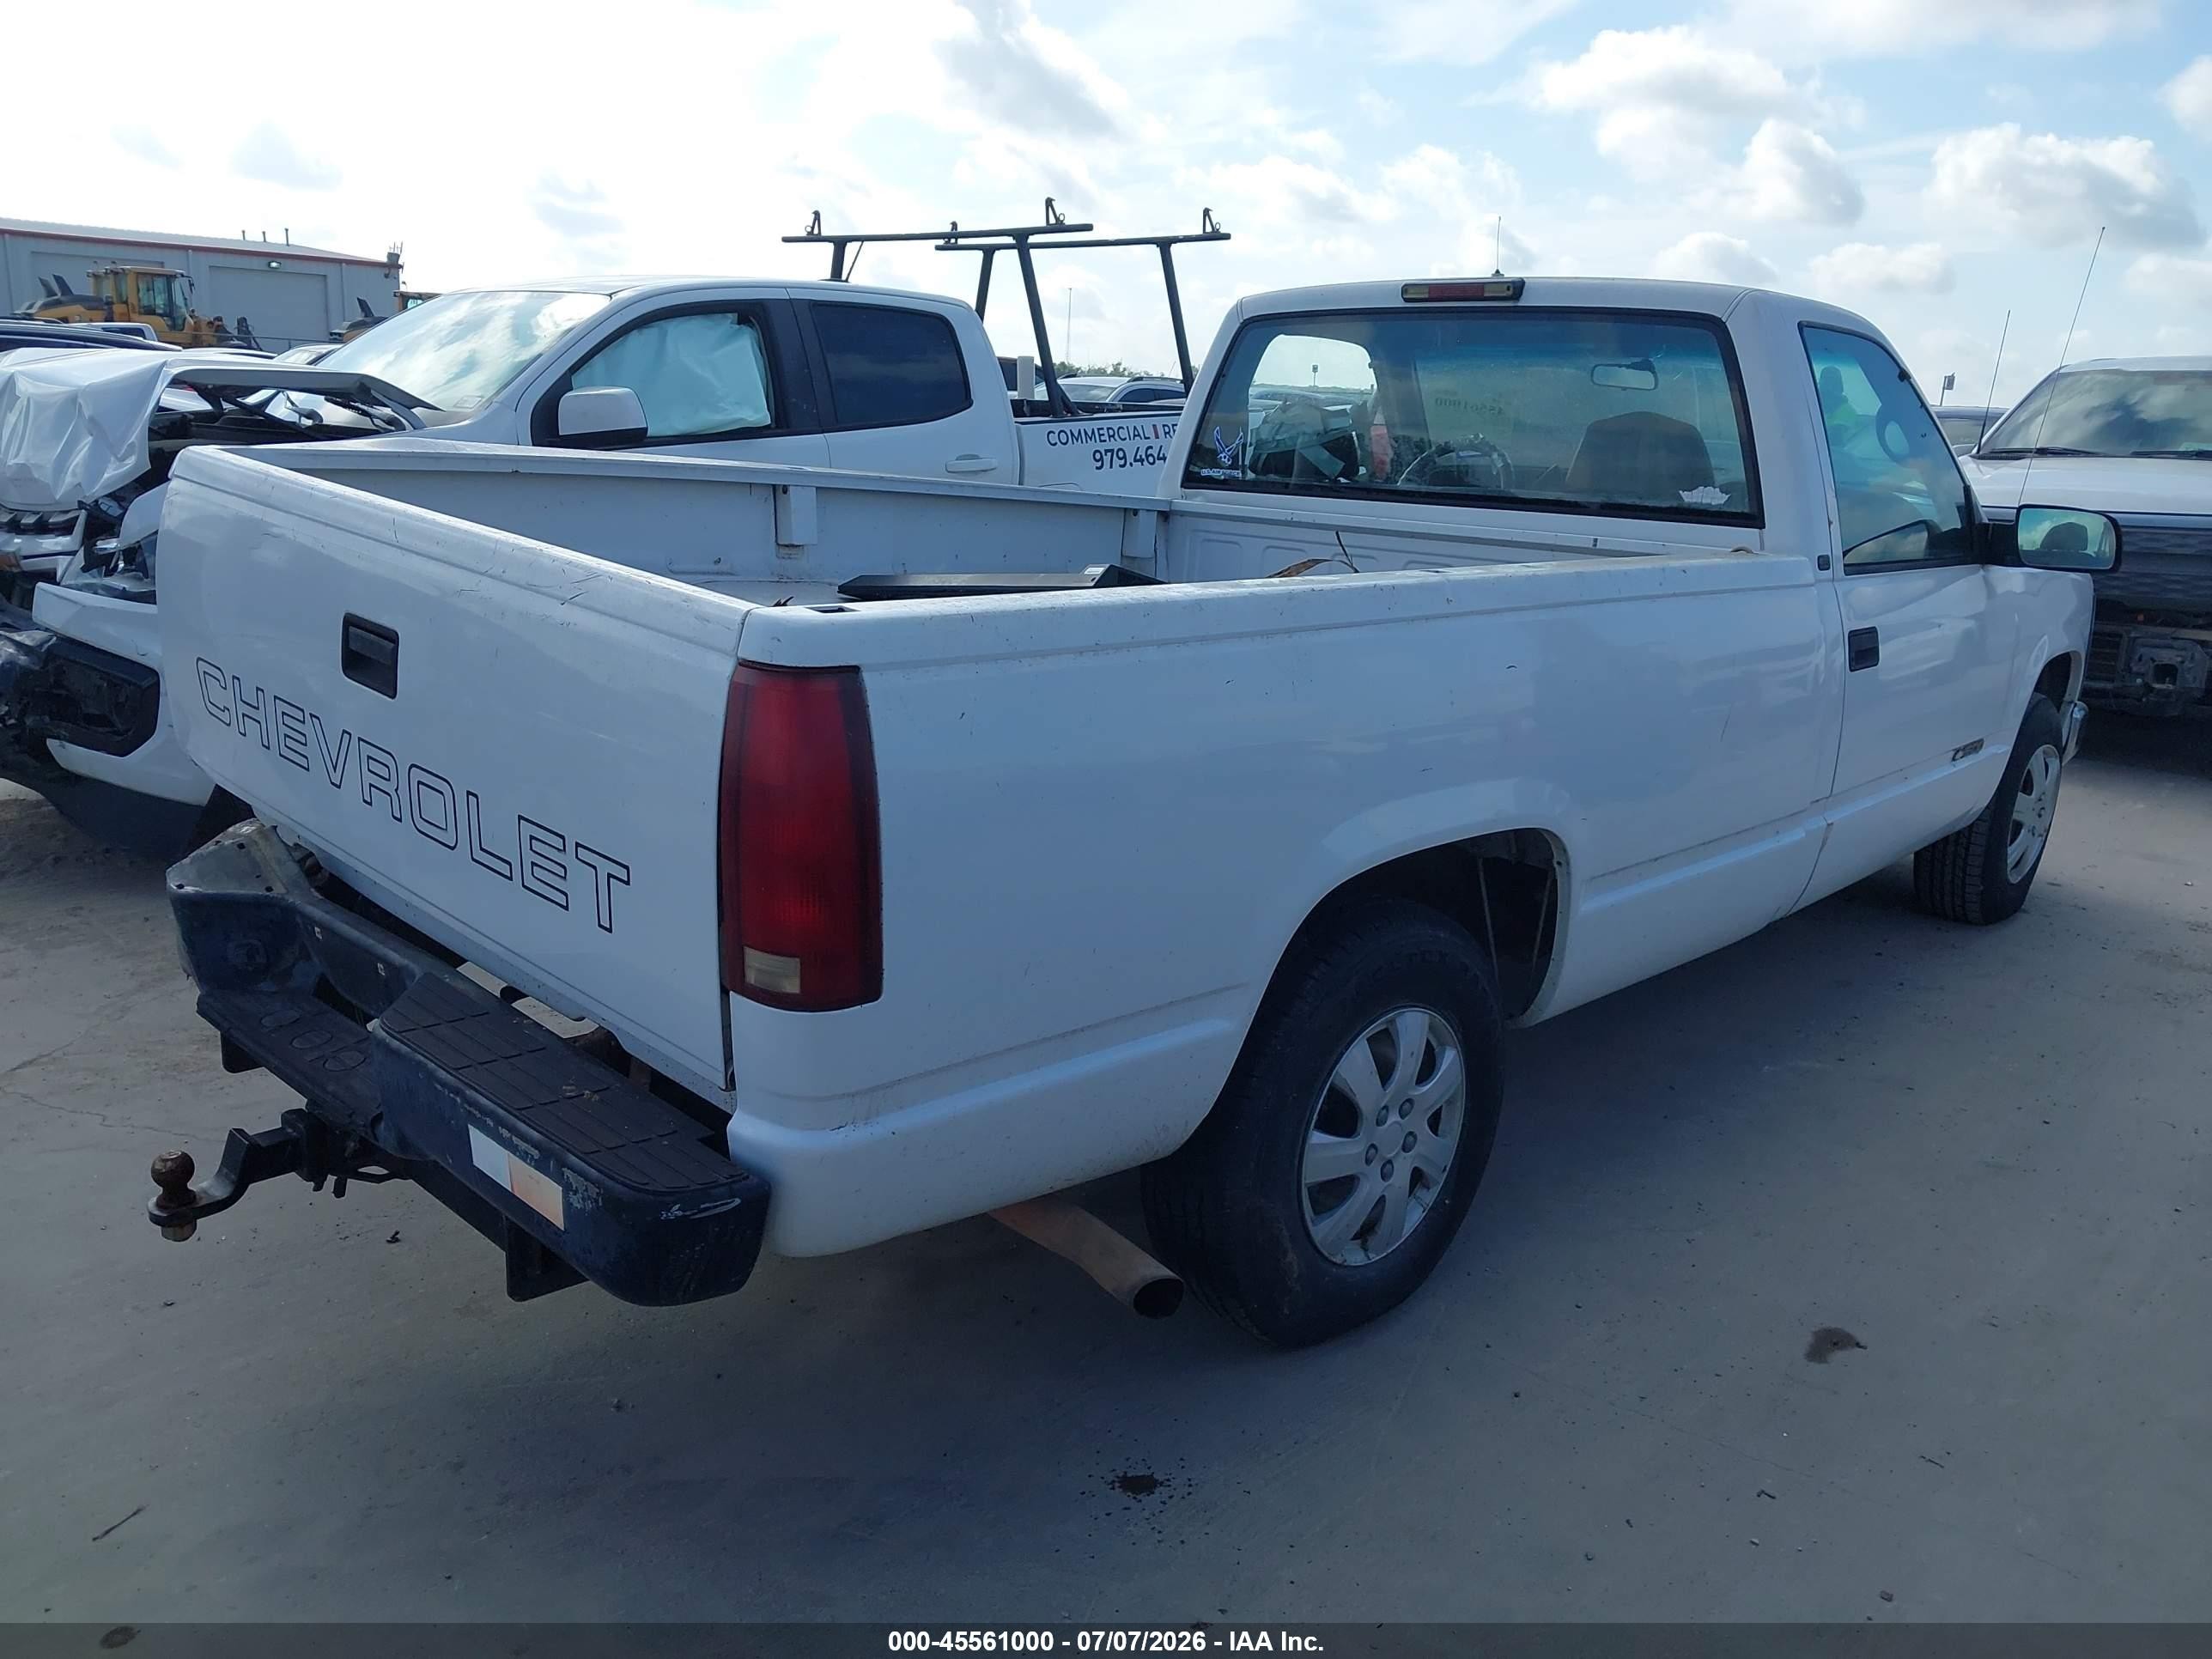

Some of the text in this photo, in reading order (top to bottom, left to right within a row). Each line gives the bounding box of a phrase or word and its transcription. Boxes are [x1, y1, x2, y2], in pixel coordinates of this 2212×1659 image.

[1046, 424, 1151, 447] COMMERCIAL
[1092, 445, 1168, 471] 979.464
[196, 656, 631, 934] CHEVROLET
